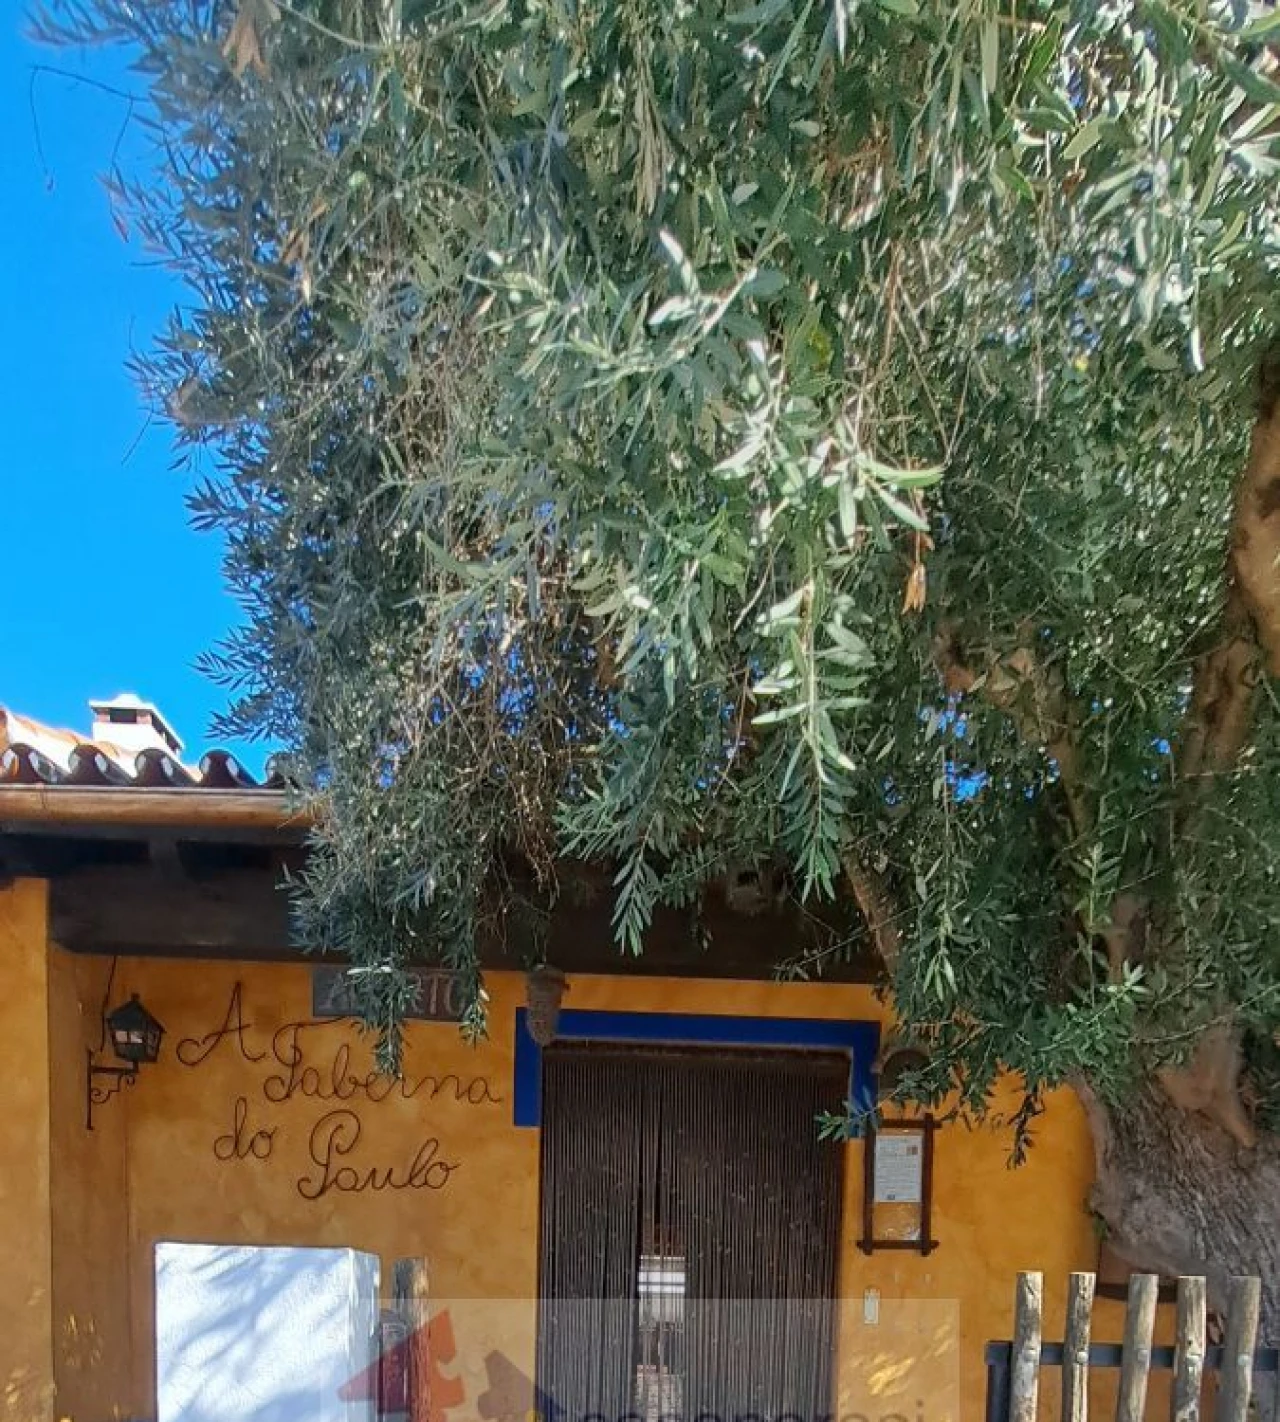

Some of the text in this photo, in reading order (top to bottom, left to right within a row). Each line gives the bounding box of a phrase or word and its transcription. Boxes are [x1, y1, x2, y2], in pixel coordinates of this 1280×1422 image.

[176, 980, 503, 1103] A Taberna
[213, 1099, 459, 1200] do Paulo
